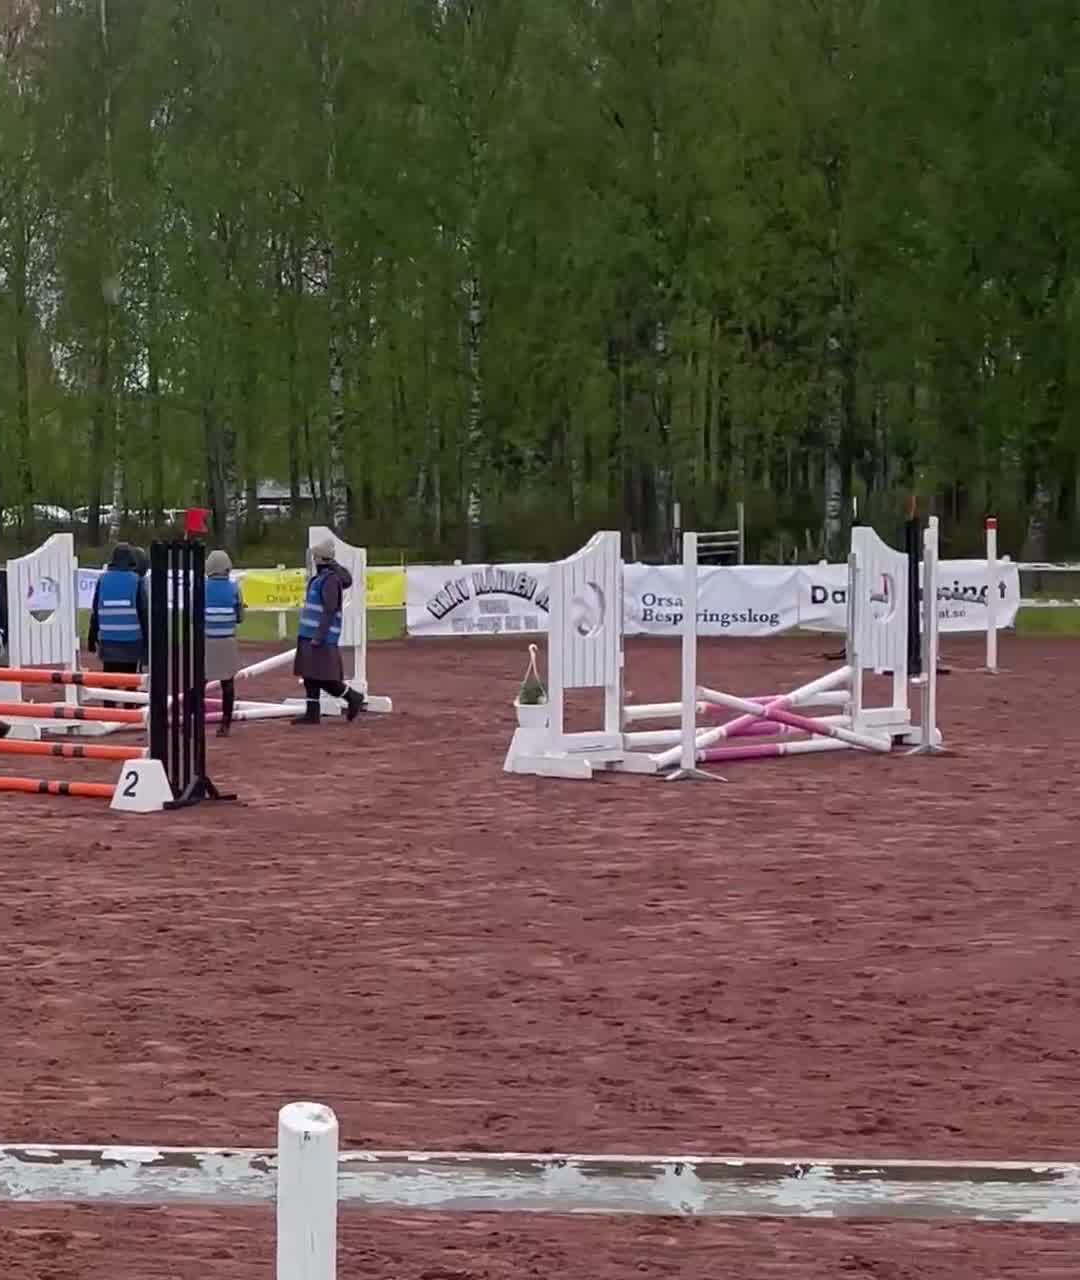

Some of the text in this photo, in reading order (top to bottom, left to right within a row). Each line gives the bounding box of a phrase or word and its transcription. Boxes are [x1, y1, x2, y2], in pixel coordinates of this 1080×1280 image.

[641, 592, 683, 607] Orsa
[641, 608, 780, 627] Bespringsskog
[122, 770, 139, 797] 2
